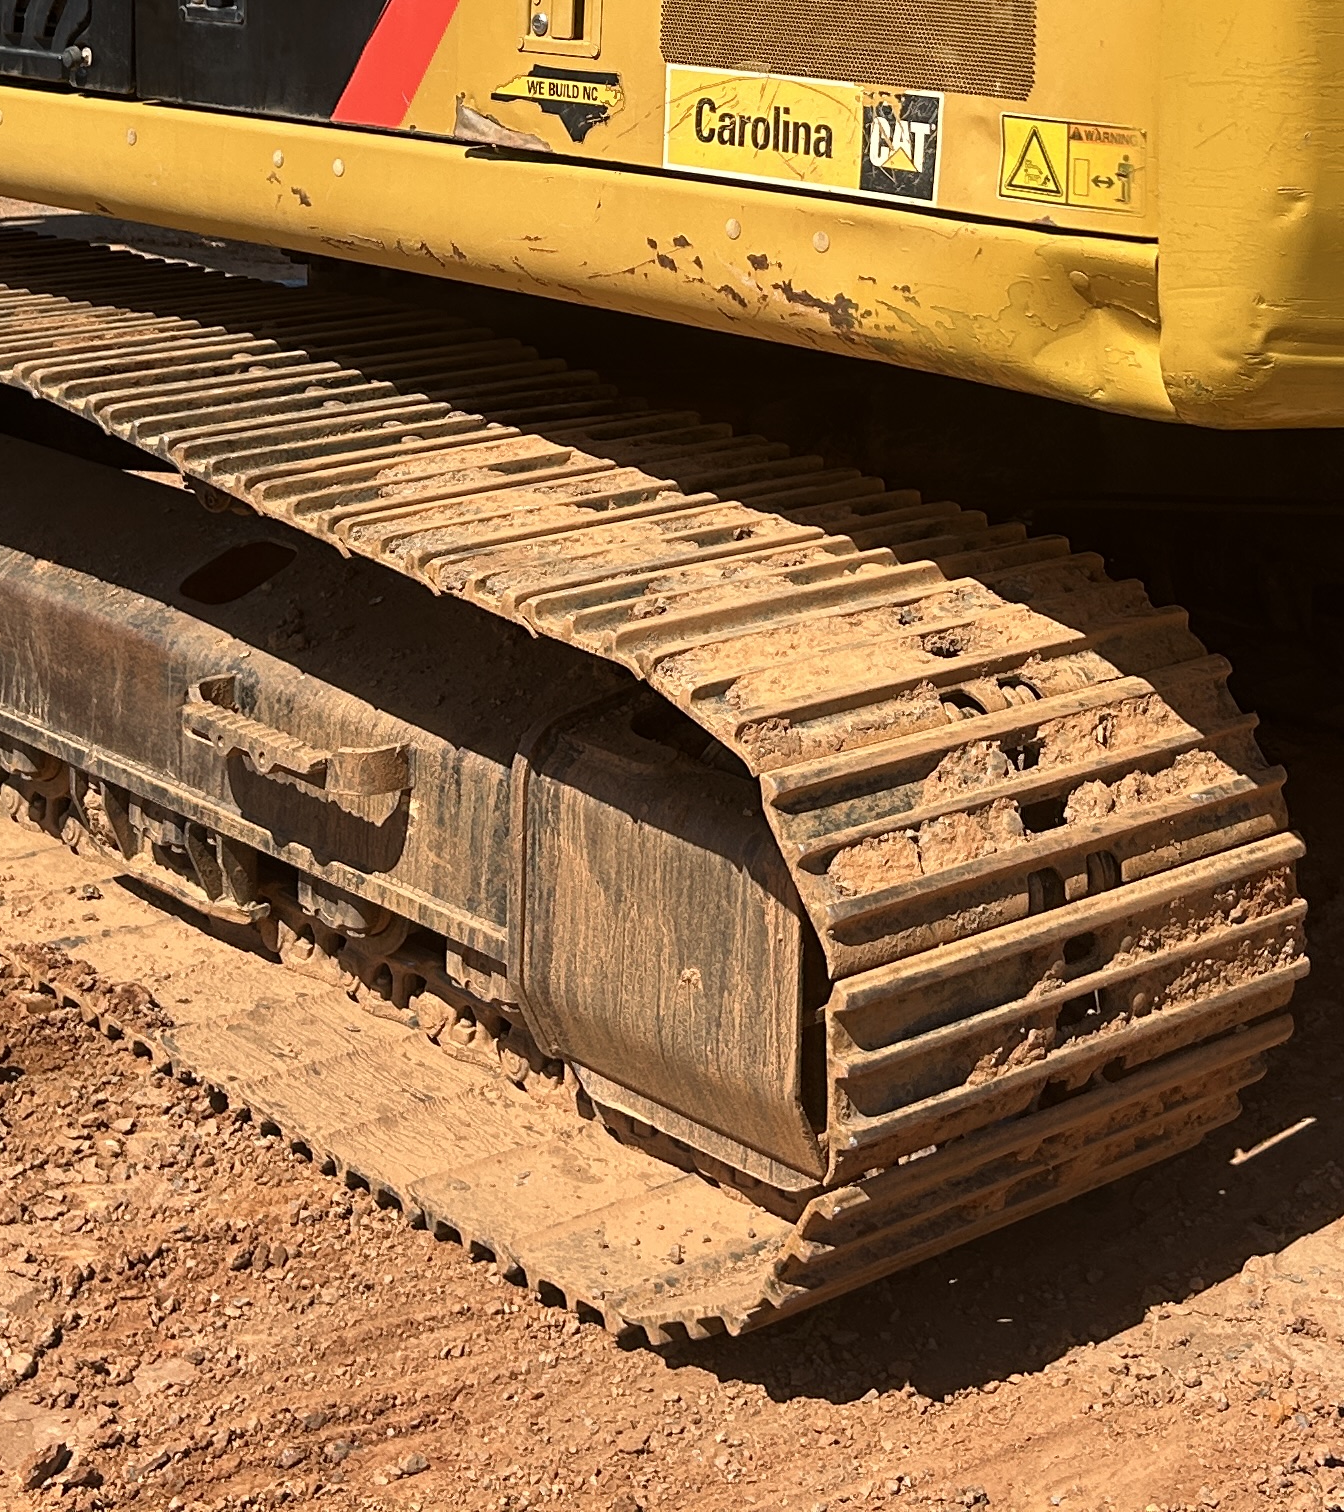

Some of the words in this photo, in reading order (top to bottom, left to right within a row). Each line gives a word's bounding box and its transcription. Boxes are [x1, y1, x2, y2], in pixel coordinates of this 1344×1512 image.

[527, 79, 545, 96] WE
[548, 82, 580, 101] BUILD
[582, 85, 598, 101] NC
[694, 97, 833, 159] Carolina
[869, 116, 931, 173] CAT
[1084, 128, 1138, 148] WARNING
